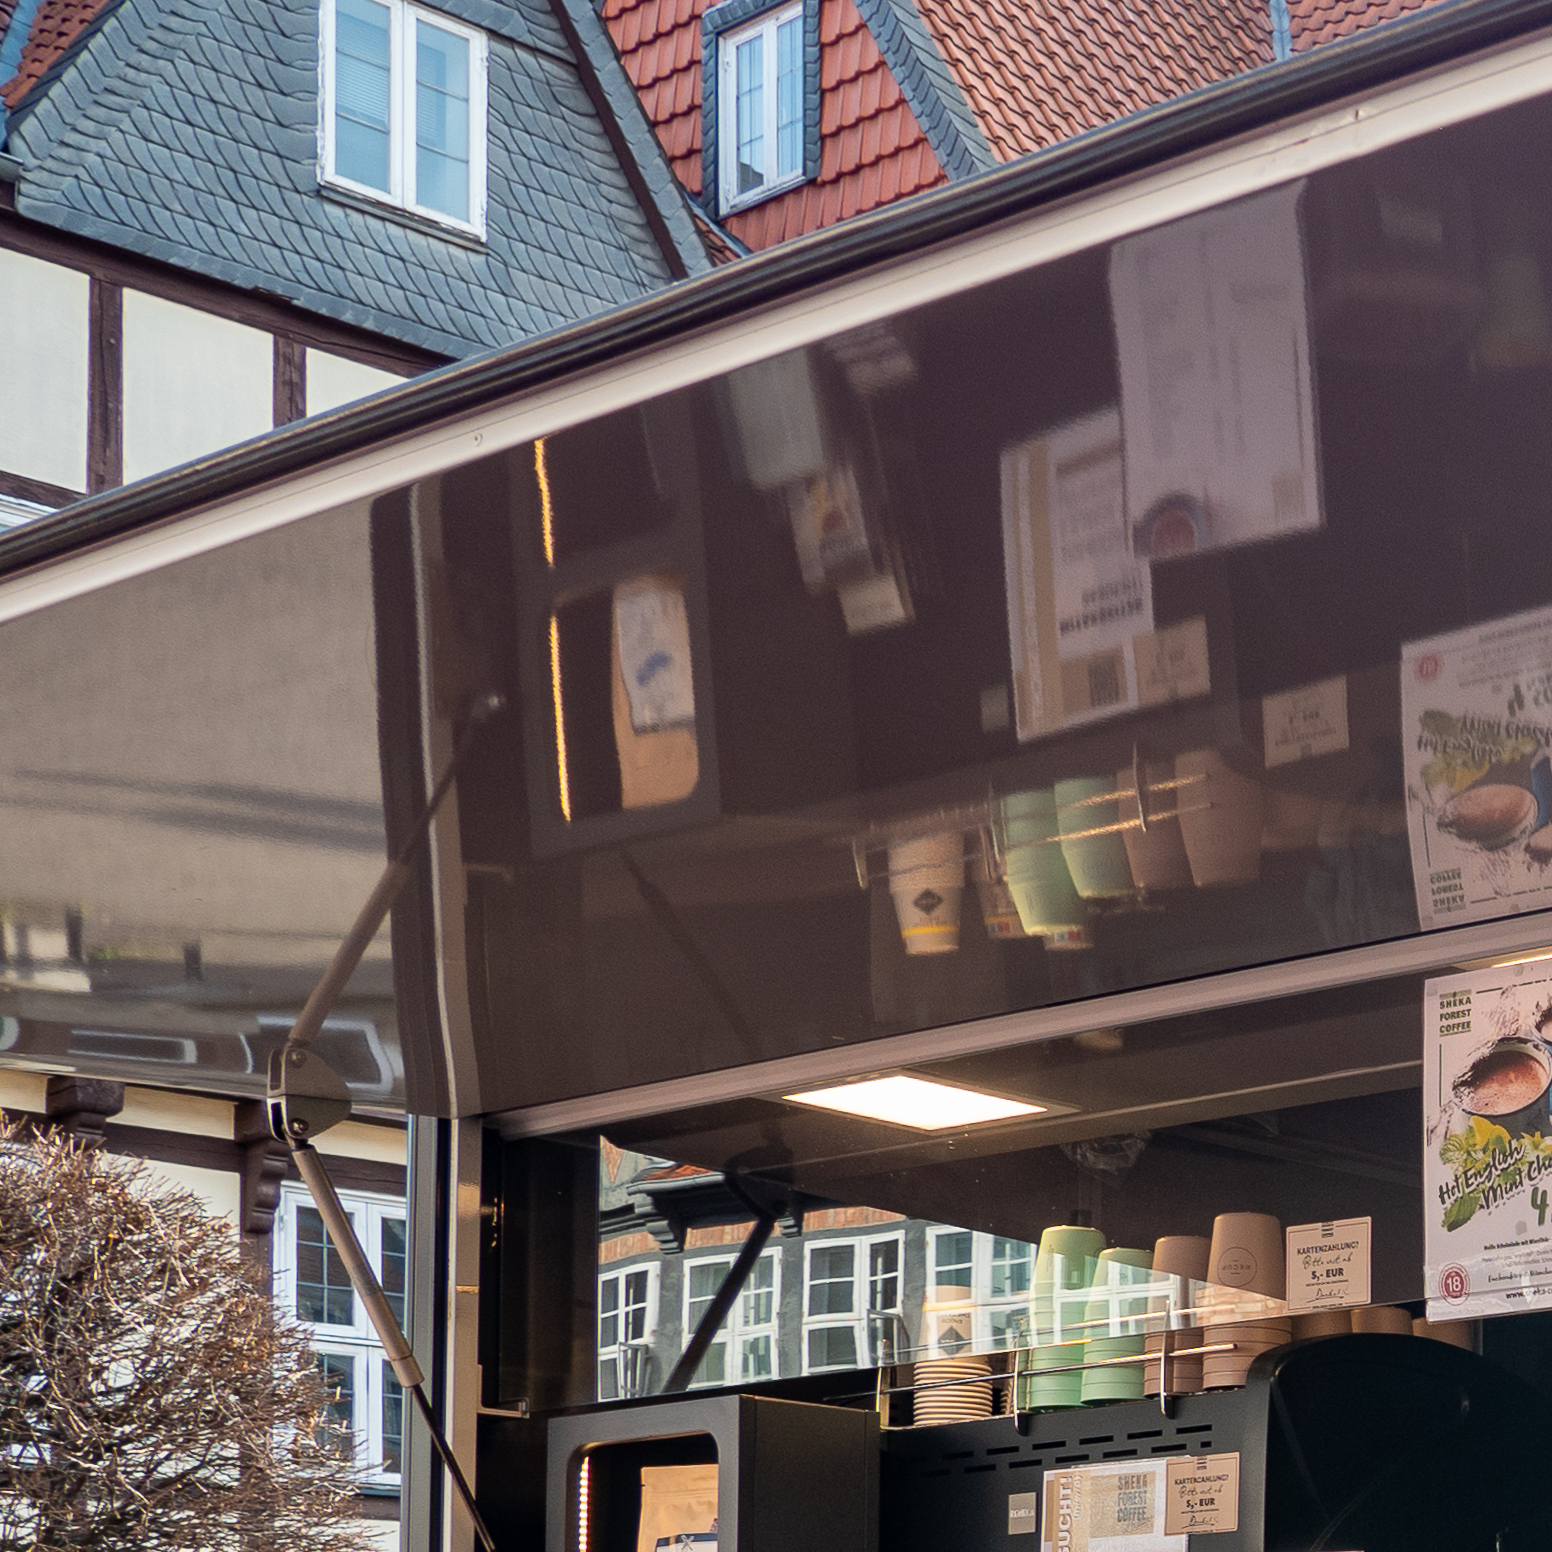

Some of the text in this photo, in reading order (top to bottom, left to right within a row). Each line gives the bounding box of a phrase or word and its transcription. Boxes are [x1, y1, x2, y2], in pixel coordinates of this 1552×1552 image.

[1439, 996, 1472, 1010] SHEKA
[1439, 1009, 1472, 1022] FOREST
[1439, 1021, 1472, 1034] COFFEE
[1439, 1138, 1524, 1206] Hot English
[1482, 1167, 1524, 1210] Mint
[1297, 1241, 1360, 1256] KARTENZAHLUNG?
[1326, 1268, 1345, 1278] EUR
[1446, 1276, 1463, 1292] 18
[1117, 1474, 1148, 1491] SHEKA
[1117, 1491, 1147, 1506] FOREST
[1199, 1498, 1216, 1507] EUR
[1117, 1507, 1147, 1523] COFFEE
